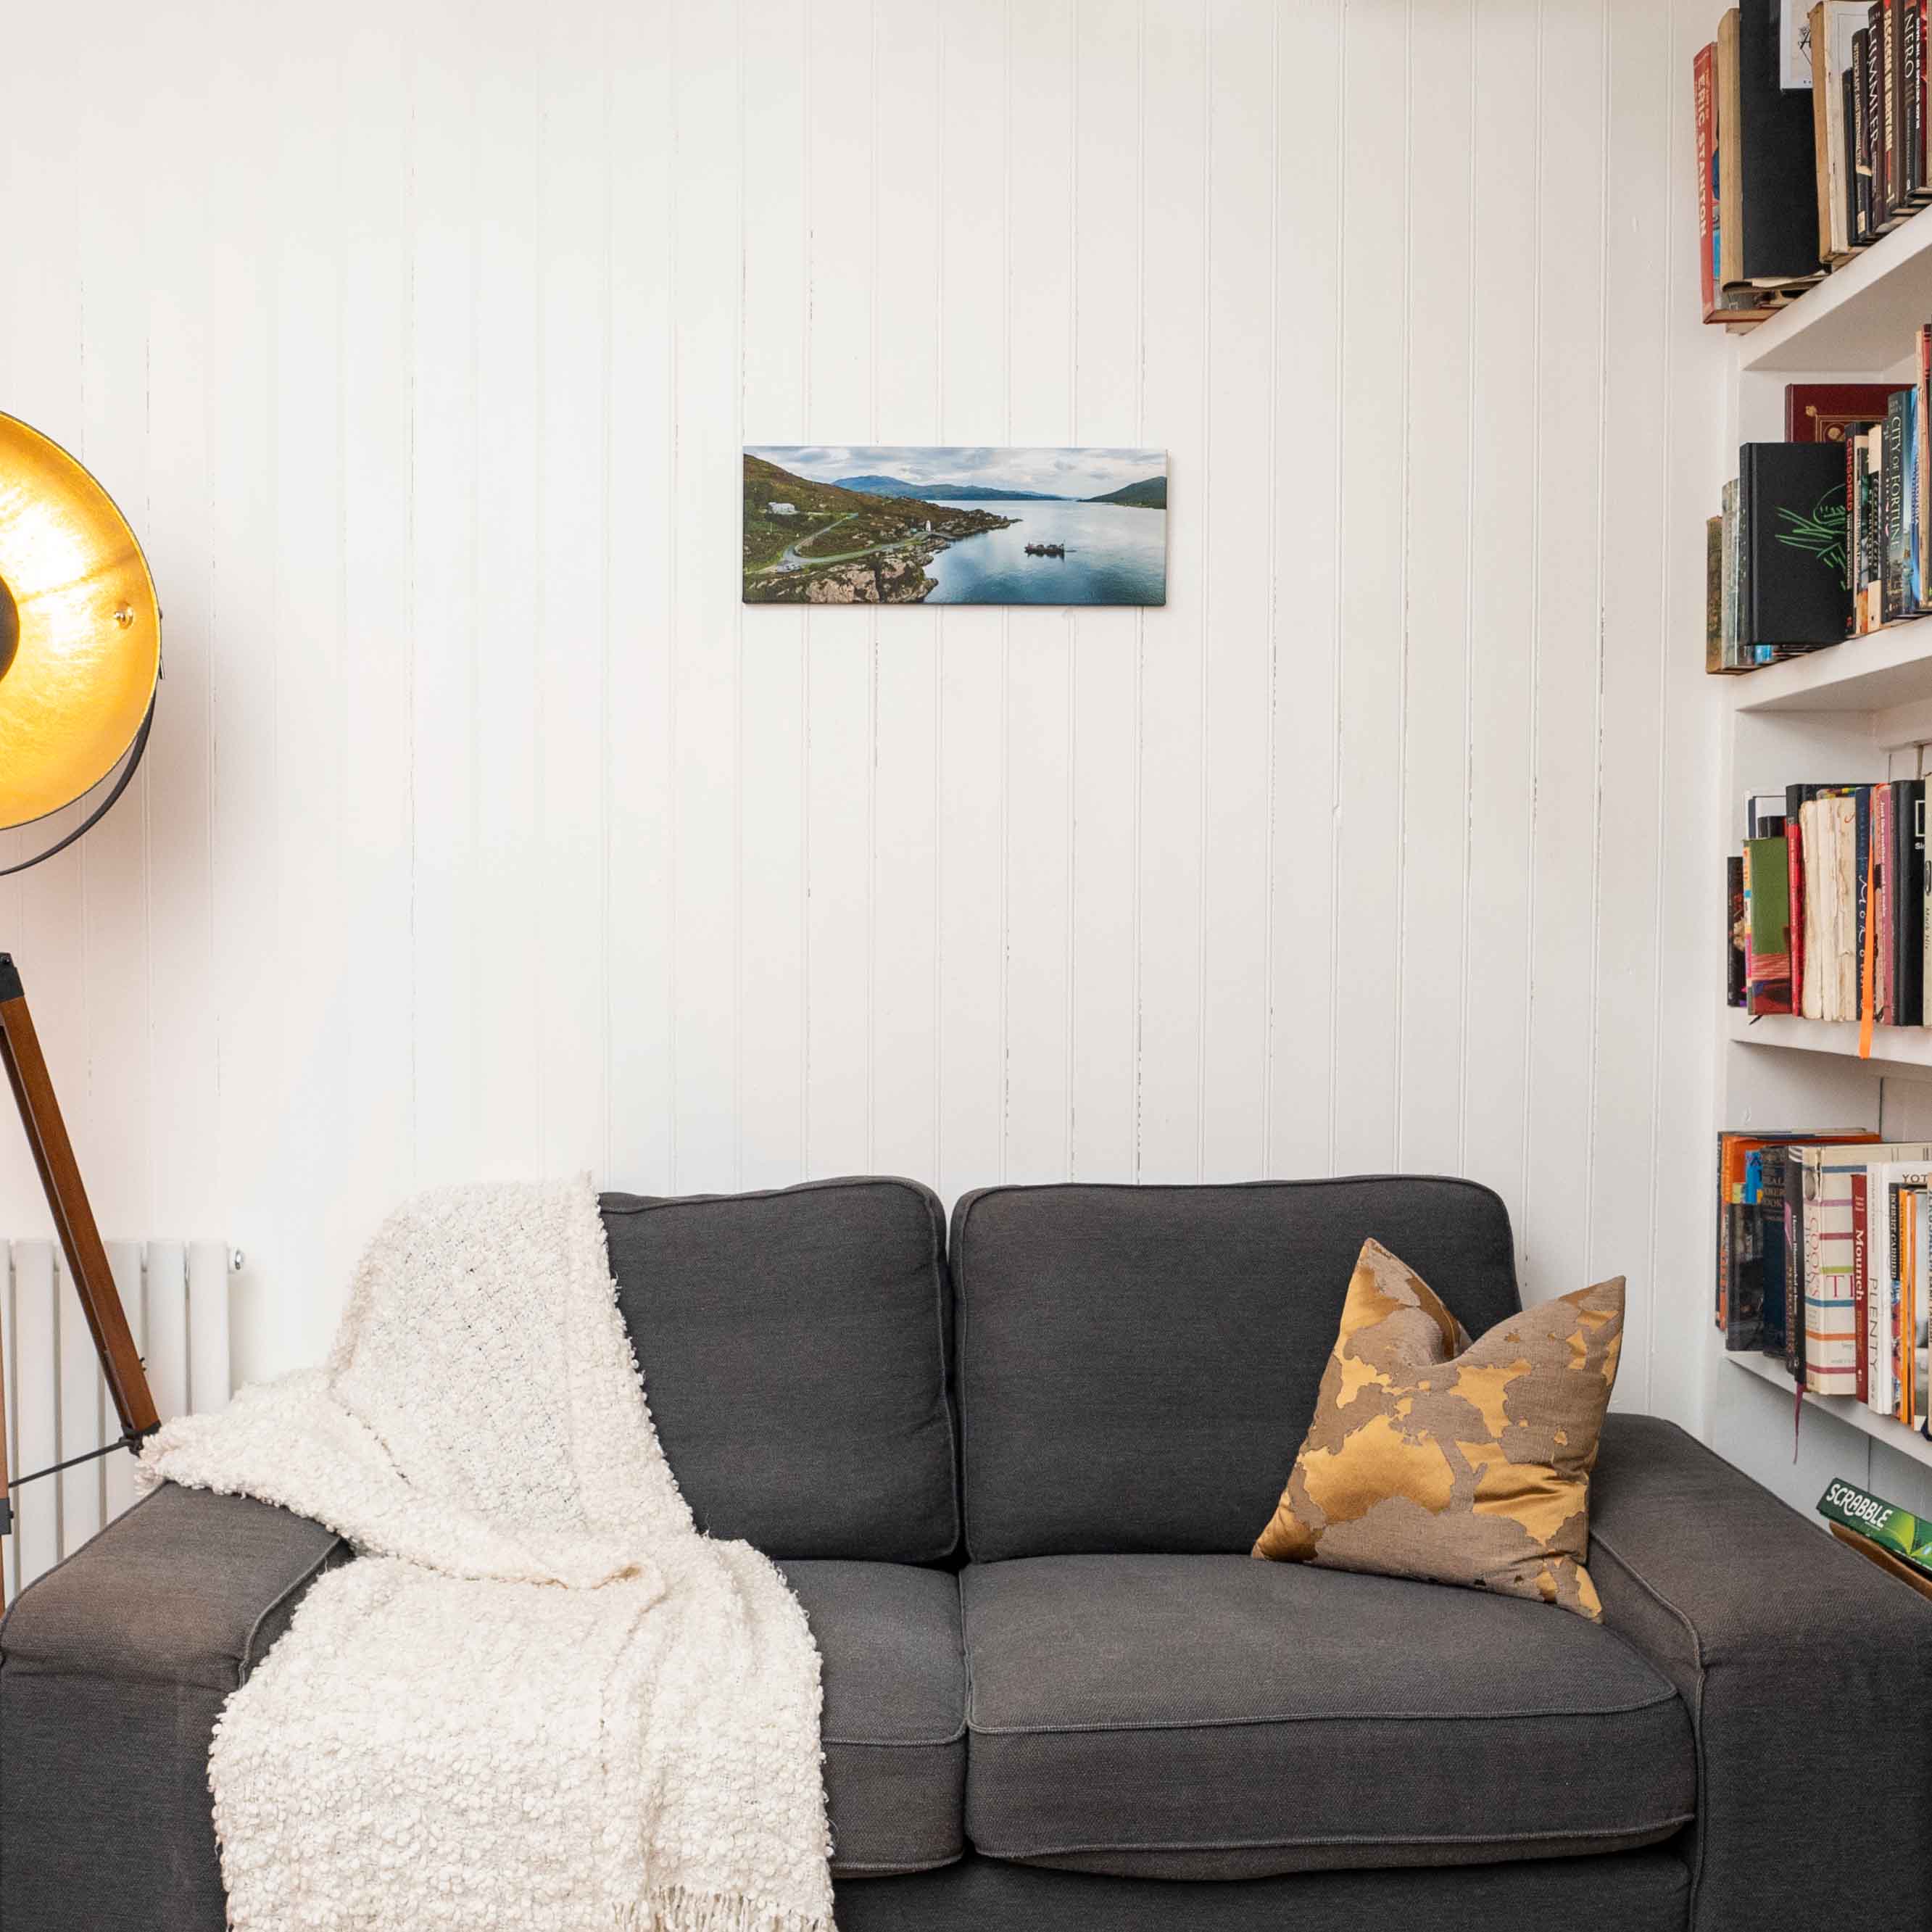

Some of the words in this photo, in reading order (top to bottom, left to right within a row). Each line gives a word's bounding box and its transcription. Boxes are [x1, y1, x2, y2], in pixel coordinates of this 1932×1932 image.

[1904, 13, 1914, 78] NERO
[1868, 24, 1879, 149] HIMMLER
[1885, 73, 1892, 91] IN
[1891, 416, 1901, 452] CITY
[1891, 475, 1901, 547] FORTUNE
[1869, 1277, 1878, 1373] PLENTY
[1826, 1483, 1893, 1528] SCRABBLE
